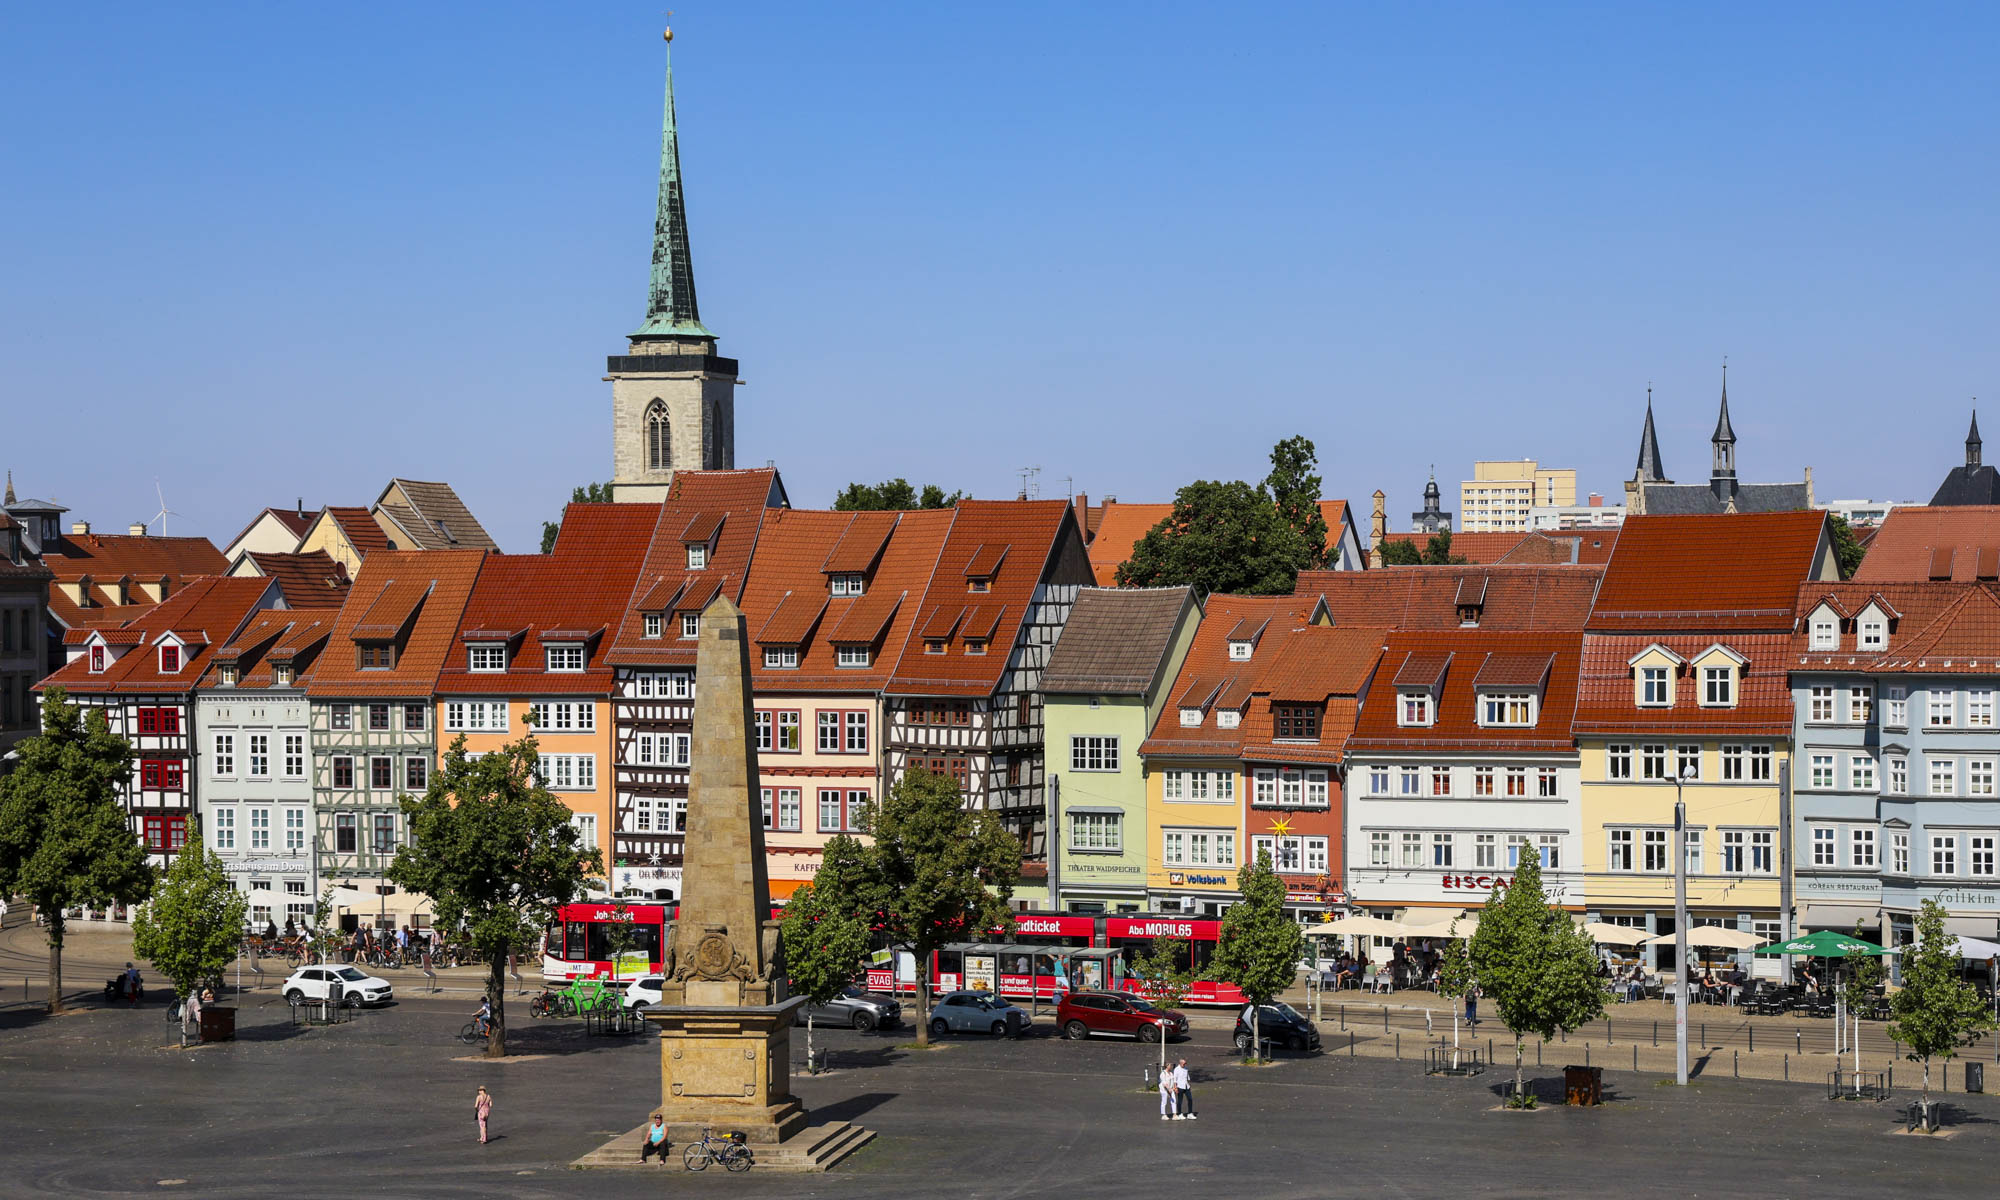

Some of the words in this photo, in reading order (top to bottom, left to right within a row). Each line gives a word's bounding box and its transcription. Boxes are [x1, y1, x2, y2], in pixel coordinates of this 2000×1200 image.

[263, 863, 279, 871] am
[281, 861, 304, 871] Dom
[794, 863, 823, 871] KAFFE
[1067, 864, 1095, 872] THEATER
[1096, 865, 1141, 873] WAIDSPEICHER
[1186, 874, 1227, 885] Volksbank
[1544, 886, 1567, 898] zia
[1934, 890, 1995, 904] wollkim
[1128, 925, 1144, 935] Abo
[1145, 923, 1192, 936] MOBIL65
[868, 974, 891, 985] EVAG
[1016, 978, 1030, 986] quer
